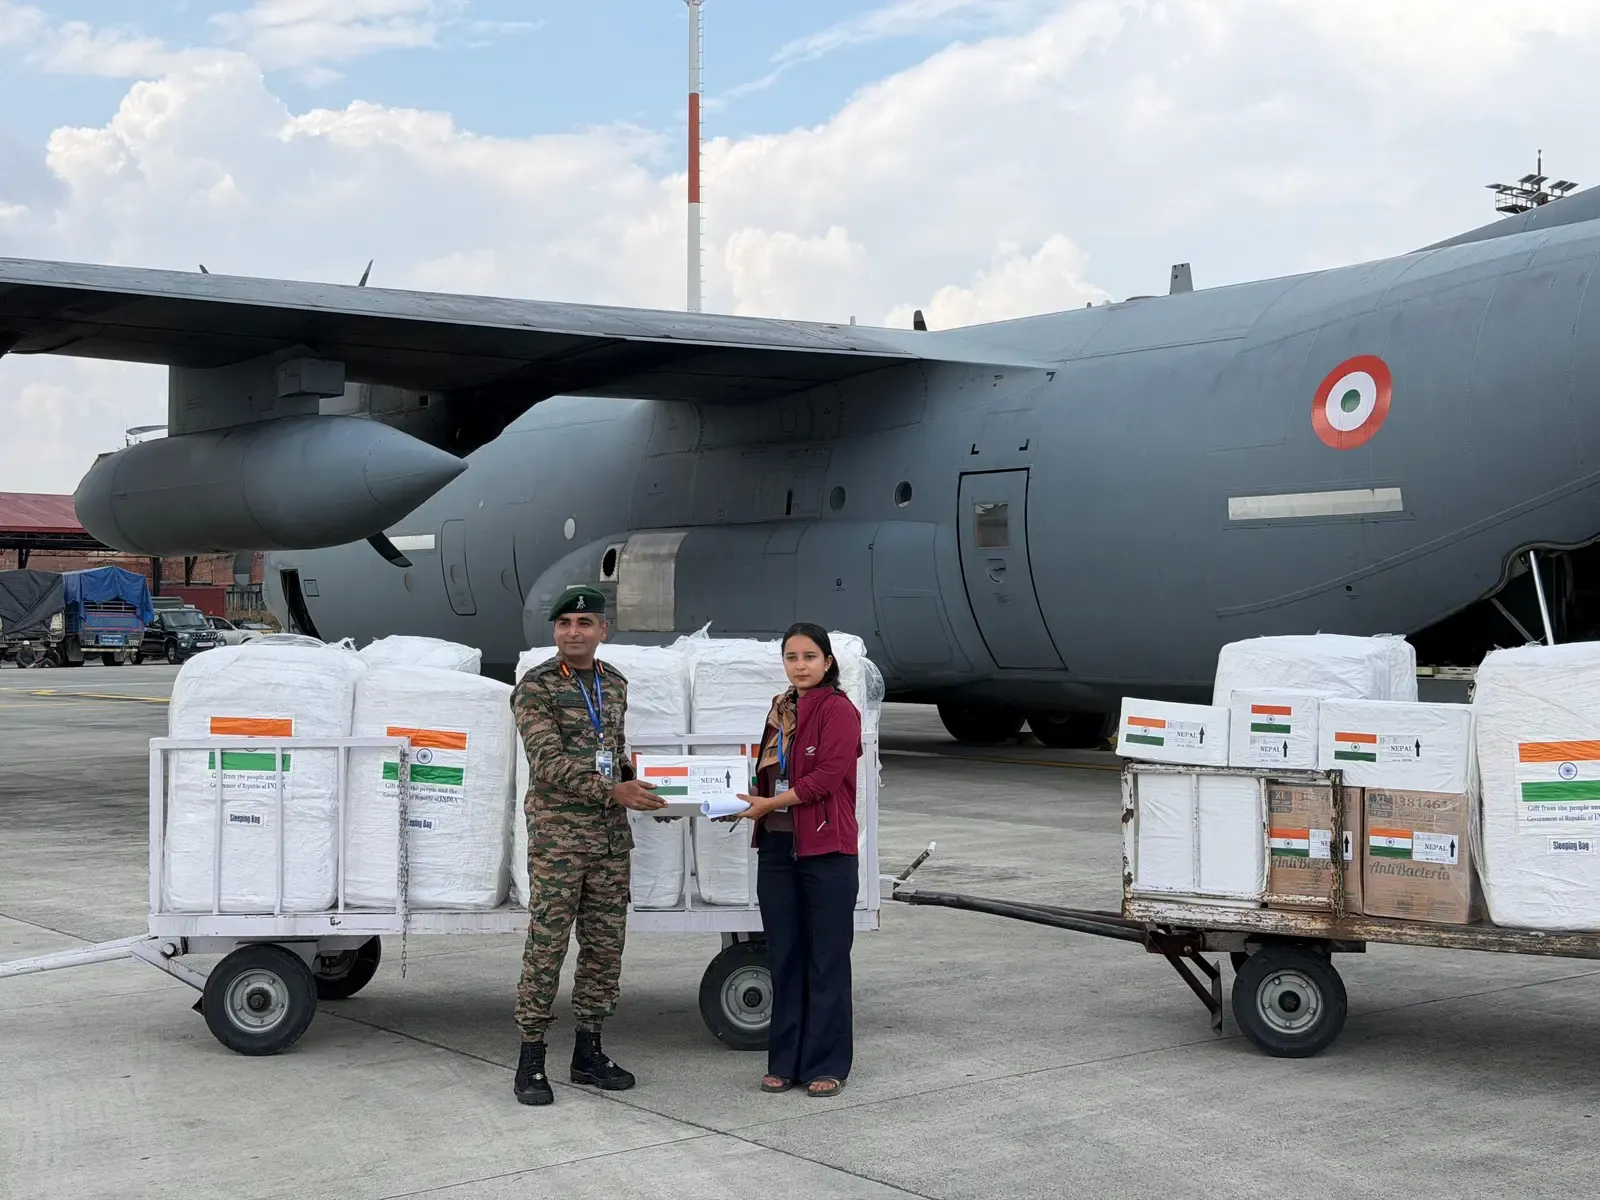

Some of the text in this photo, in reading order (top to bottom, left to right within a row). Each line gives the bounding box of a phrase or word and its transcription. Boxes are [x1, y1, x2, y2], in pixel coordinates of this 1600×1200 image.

[1176, 731, 1198, 739] NEPAL
[1569, 804, 1590, 812] people
[229, 813, 261, 824] Sleeping Bag
[1564, 814, 1586, 822] Republic
[423, 819, 433, 829] Bag
[1424, 843, 1448, 852] NEPAL
[1552, 840, 1589, 851] Sleeping Bag
